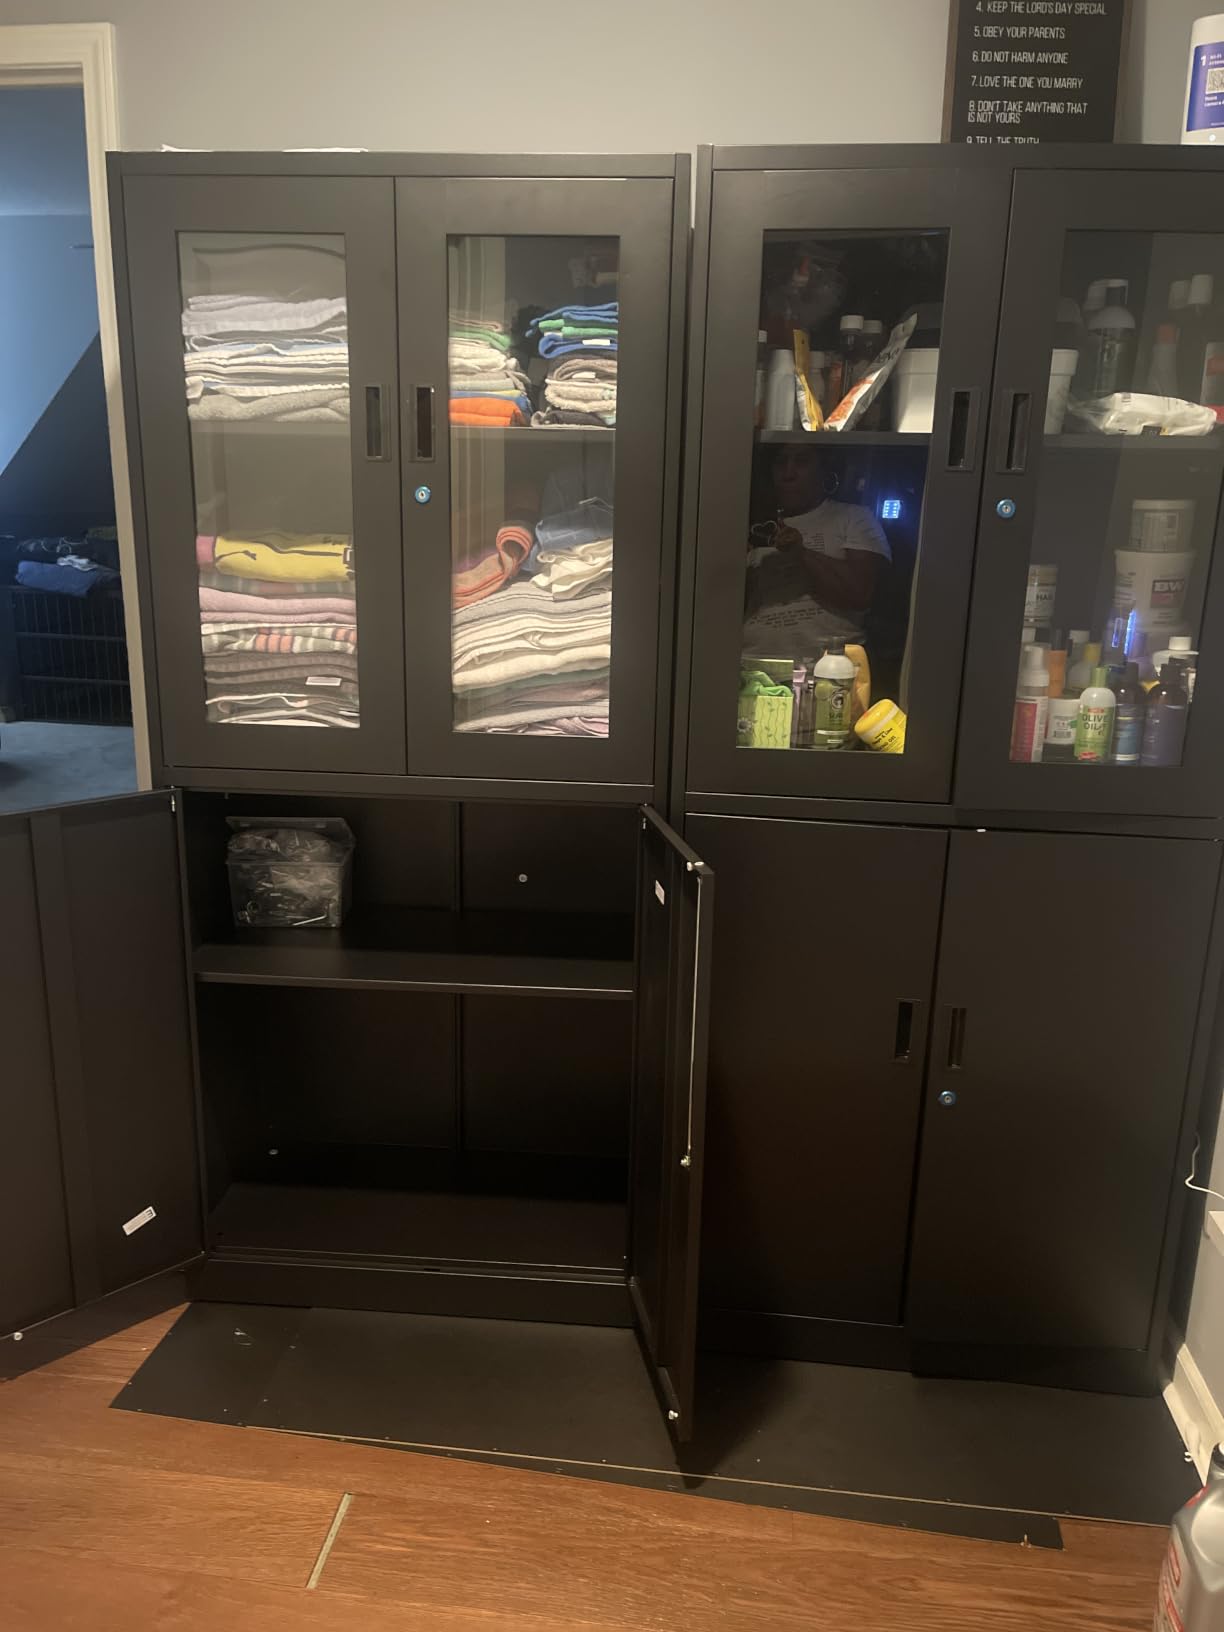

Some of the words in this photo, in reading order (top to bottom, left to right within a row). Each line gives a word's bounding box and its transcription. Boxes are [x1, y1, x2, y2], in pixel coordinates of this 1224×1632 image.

[987, 1, 1008, 13] KEEP
[1010, 1, 1025, 13] THE
[1055, 2, 1073, 14] DAY
[1074, 2, 1108, 15] SPECIAL
[982, 25, 1004, 38] OBEY
[1006, 26, 1028, 38] YOUR
[1028, 26, 1066, 39] PARENTS
[981, 50, 993, 63] DO
[993, 50, 1010, 63] NOT
[1011, 51, 1035, 63] HARM
[1036, 52, 1069, 64] ANYONE
[971, 75, 978, 87] 7.
[979, 75, 1001, 87] LOVE
[1002, 75, 1018, 88] THE
[1019, 76, 1035, 88] ONE
[1036, 76, 1053, 89] YOU
[1053, 77, 1084, 89] MARRY
[1002, 100, 1024, 112] TAKE
[1025, 101, 1065, 113] ANYTHING
[1066, 102, 1089, 114] THAT
[967, 111, 976, 123] IS
[977, 112, 993, 123] NOT
[994, 112, 1021, 124] YOURS
